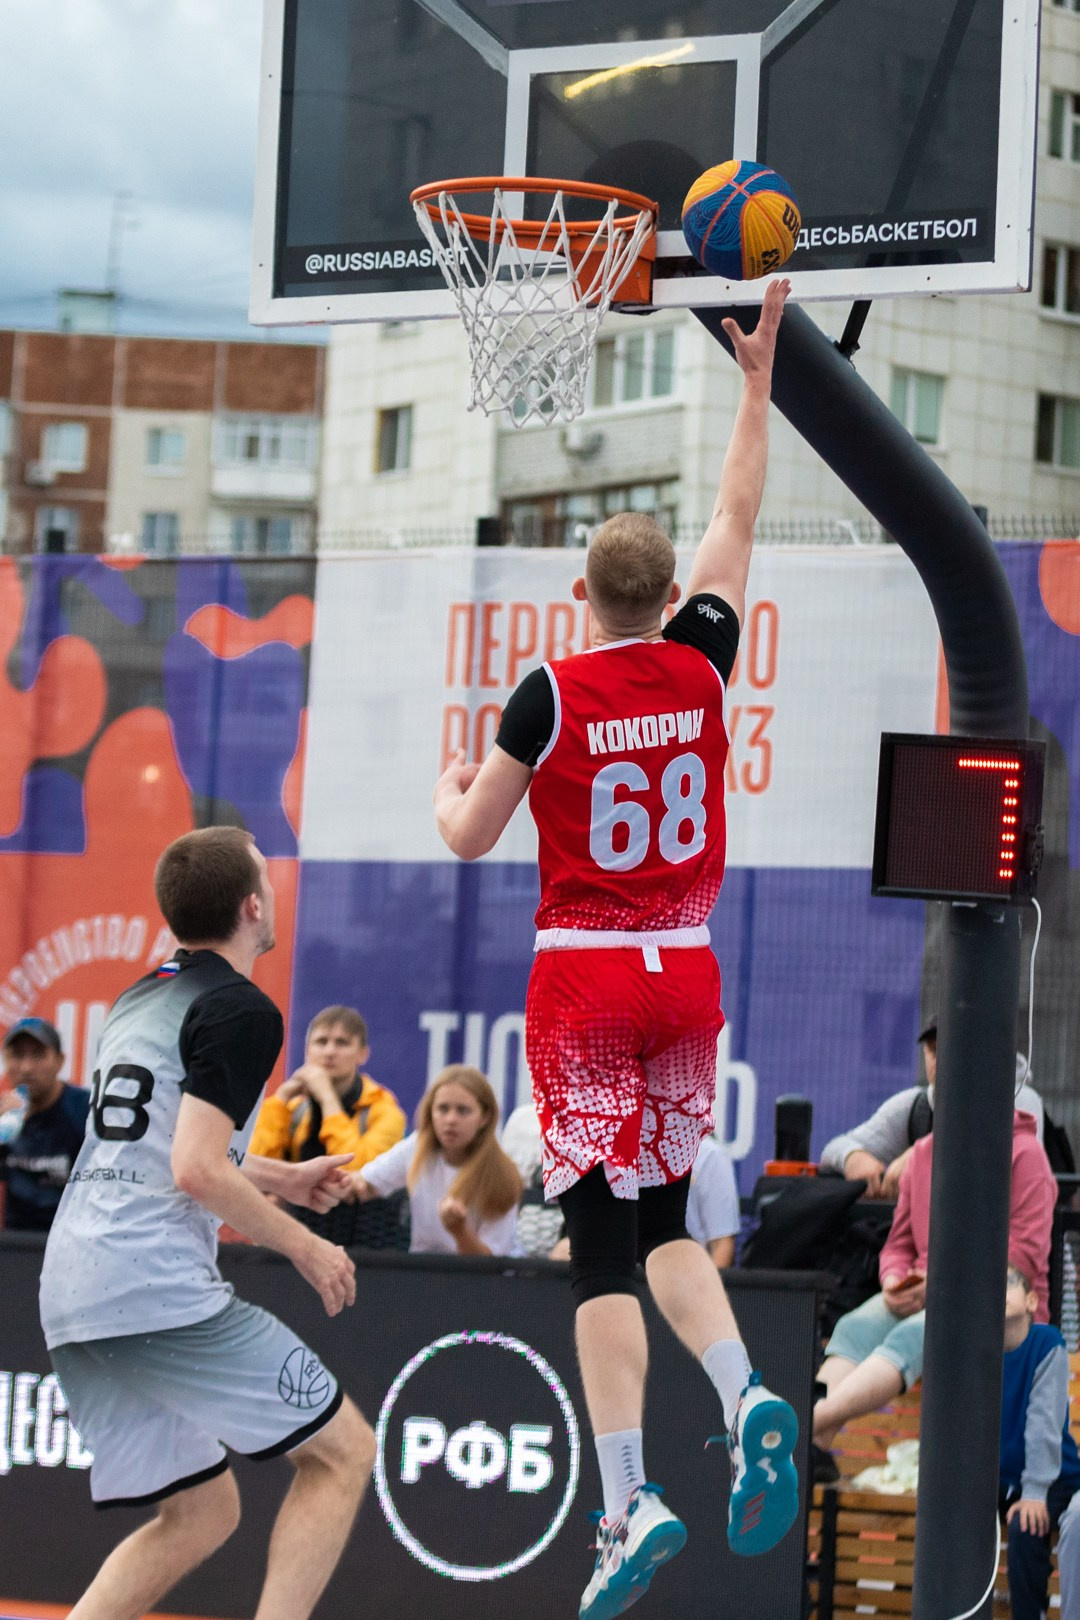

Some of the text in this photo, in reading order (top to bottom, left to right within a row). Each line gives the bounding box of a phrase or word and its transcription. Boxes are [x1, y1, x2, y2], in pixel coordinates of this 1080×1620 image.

[795, 218, 977, 251] ДЕСЬБАСКЕТБОЛ
[587, 708, 704, 755] КОКОРИН
[589, 752, 707, 873] 68
[90, 1064, 154, 1141] 8
[400, 1416, 554, 1494] РФБ
